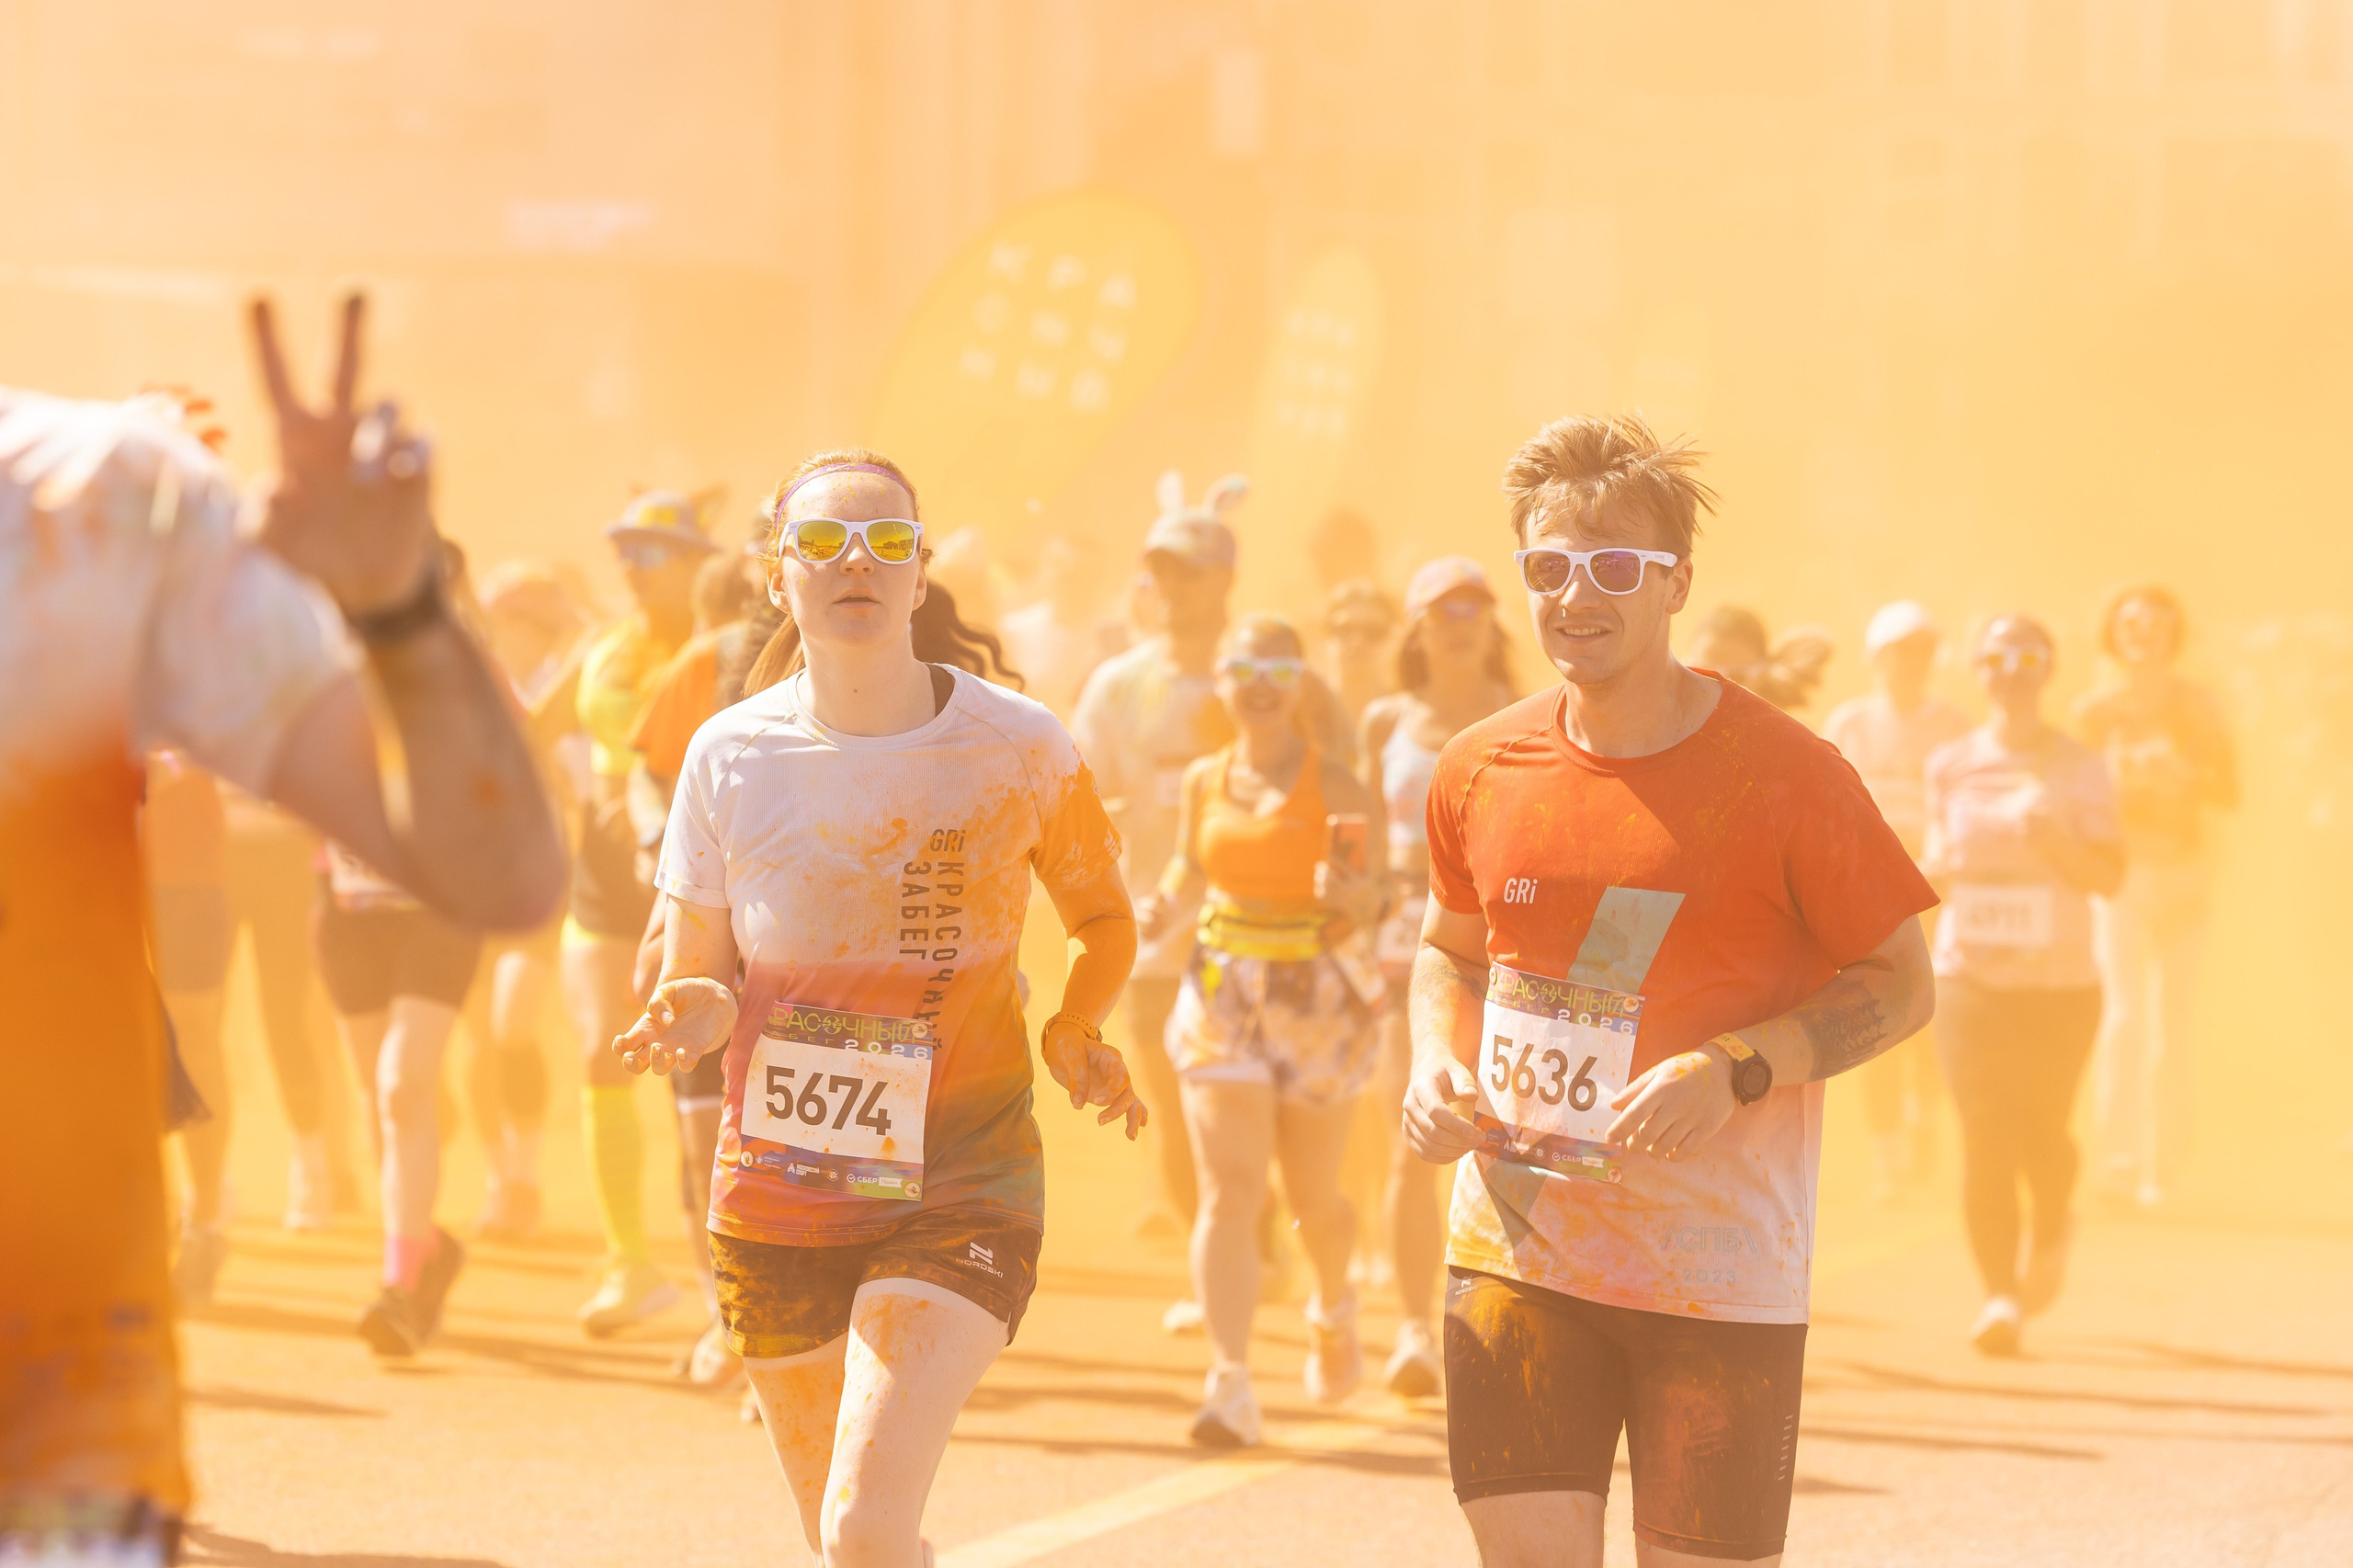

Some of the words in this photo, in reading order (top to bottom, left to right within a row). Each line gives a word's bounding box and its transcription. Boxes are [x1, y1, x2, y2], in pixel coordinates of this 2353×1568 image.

[1504, 877, 1538, 904] GRi
[899, 862, 931, 960] ЗАБЕГ
[1495, 995, 1550, 1014] АБЕГ
[1558, 1008, 1633, 1035] 2026
[764, 1027, 835, 1044] АБЕГ
[845, 1039, 928, 1061] 2026
[1491, 1034, 1598, 1112] 5636
[766, 1064, 892, 1136] 5674
[857, 1176, 878, 1184] СБЕР
[956, 1258, 1004, 1278] NORDSKI
[1683, 1268, 1736, 1284] 2023
